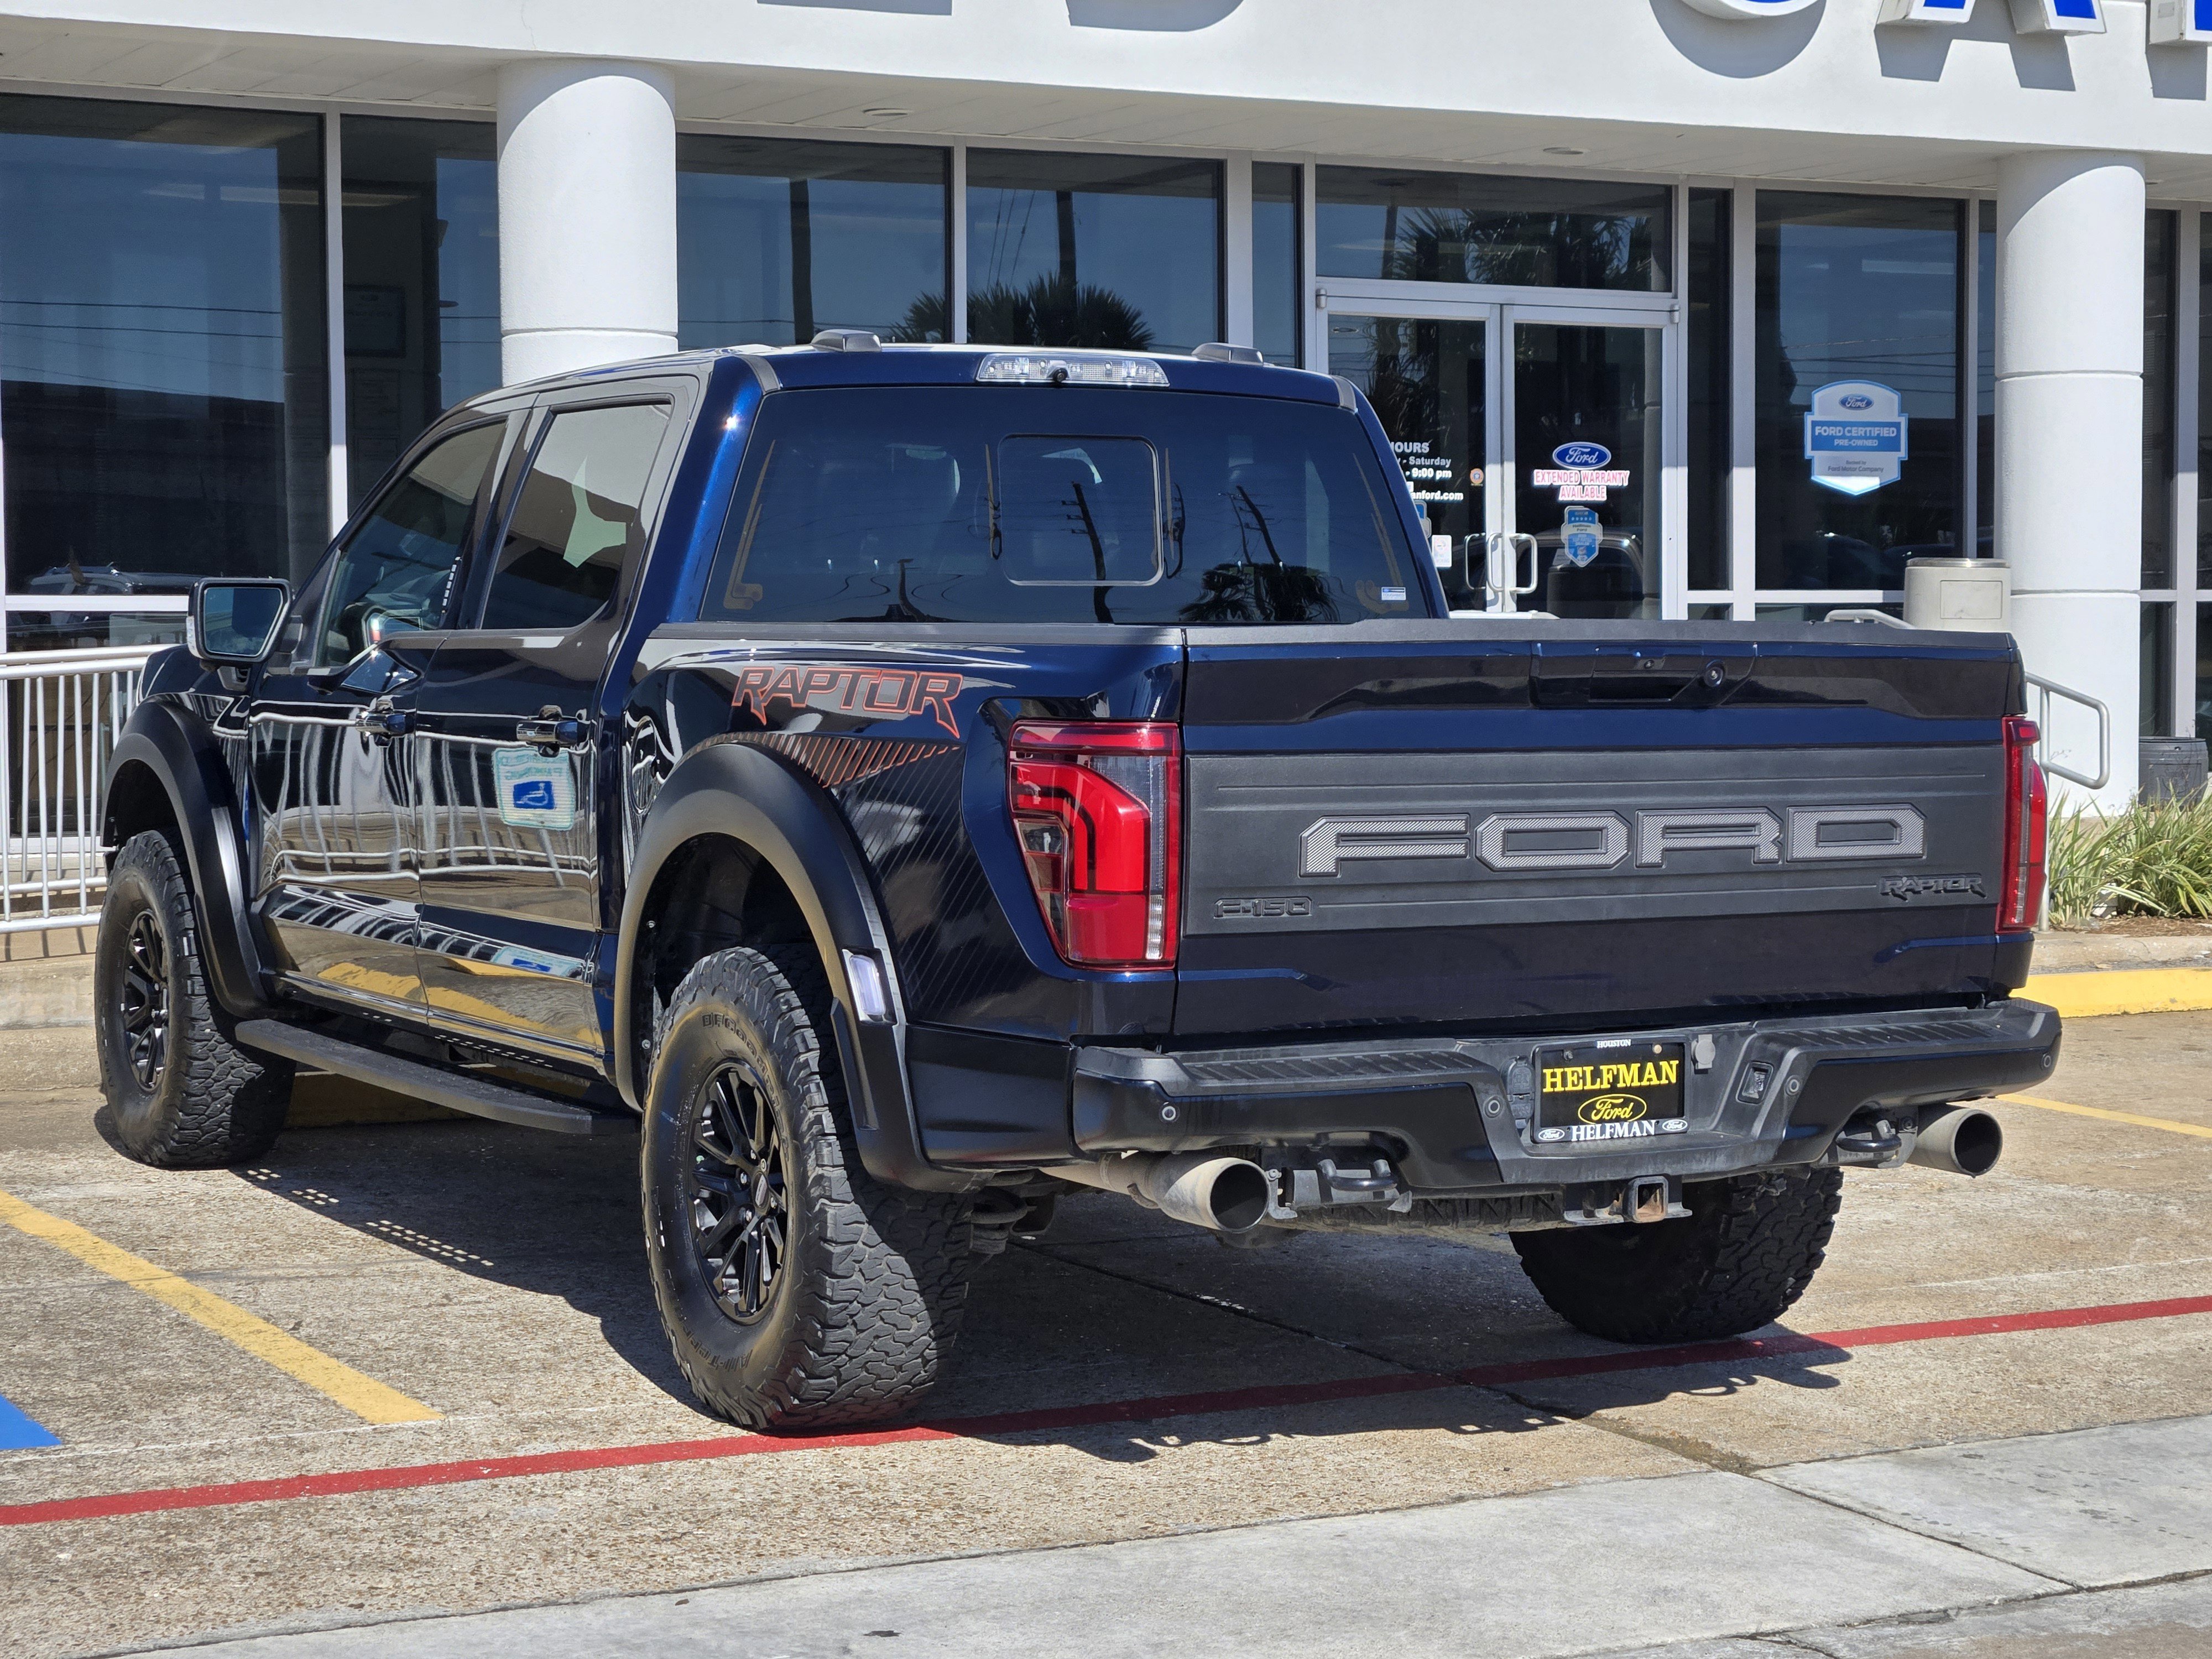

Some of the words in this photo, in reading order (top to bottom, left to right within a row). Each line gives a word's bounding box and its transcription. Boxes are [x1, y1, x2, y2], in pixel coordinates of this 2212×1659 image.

[1845, 396, 1867, 408] Ford
[1815, 426, 1843, 436] FORD
[1845, 426, 1897, 437] CERTIFIED
[1409, 456, 1451, 468] Saturday
[1566, 447, 1599, 463] Ford
[1412, 468, 1434, 477] 9:00
[1436, 470, 1452, 480] pm
[1535, 471, 1579, 484] EXTENDED
[1582, 471, 1629, 484] WARRANTY
[1410, 490, 1464, 500] anford.com
[1560, 486, 1606, 499] AVAILABLE
[732, 667, 963, 739] RAPTOR
[1298, 804, 1927, 877] FORD
[1880, 873, 1987, 902] RAPTOR
[1214, 897, 1312, 919] F-150
[1597, 1039, 1631, 1048] HOUSTON
[1543, 1060, 1679, 1092] HELFMAN
[1591, 1098, 1634, 1121] Ford
[1571, 1120, 1656, 1141] HELFMAN
